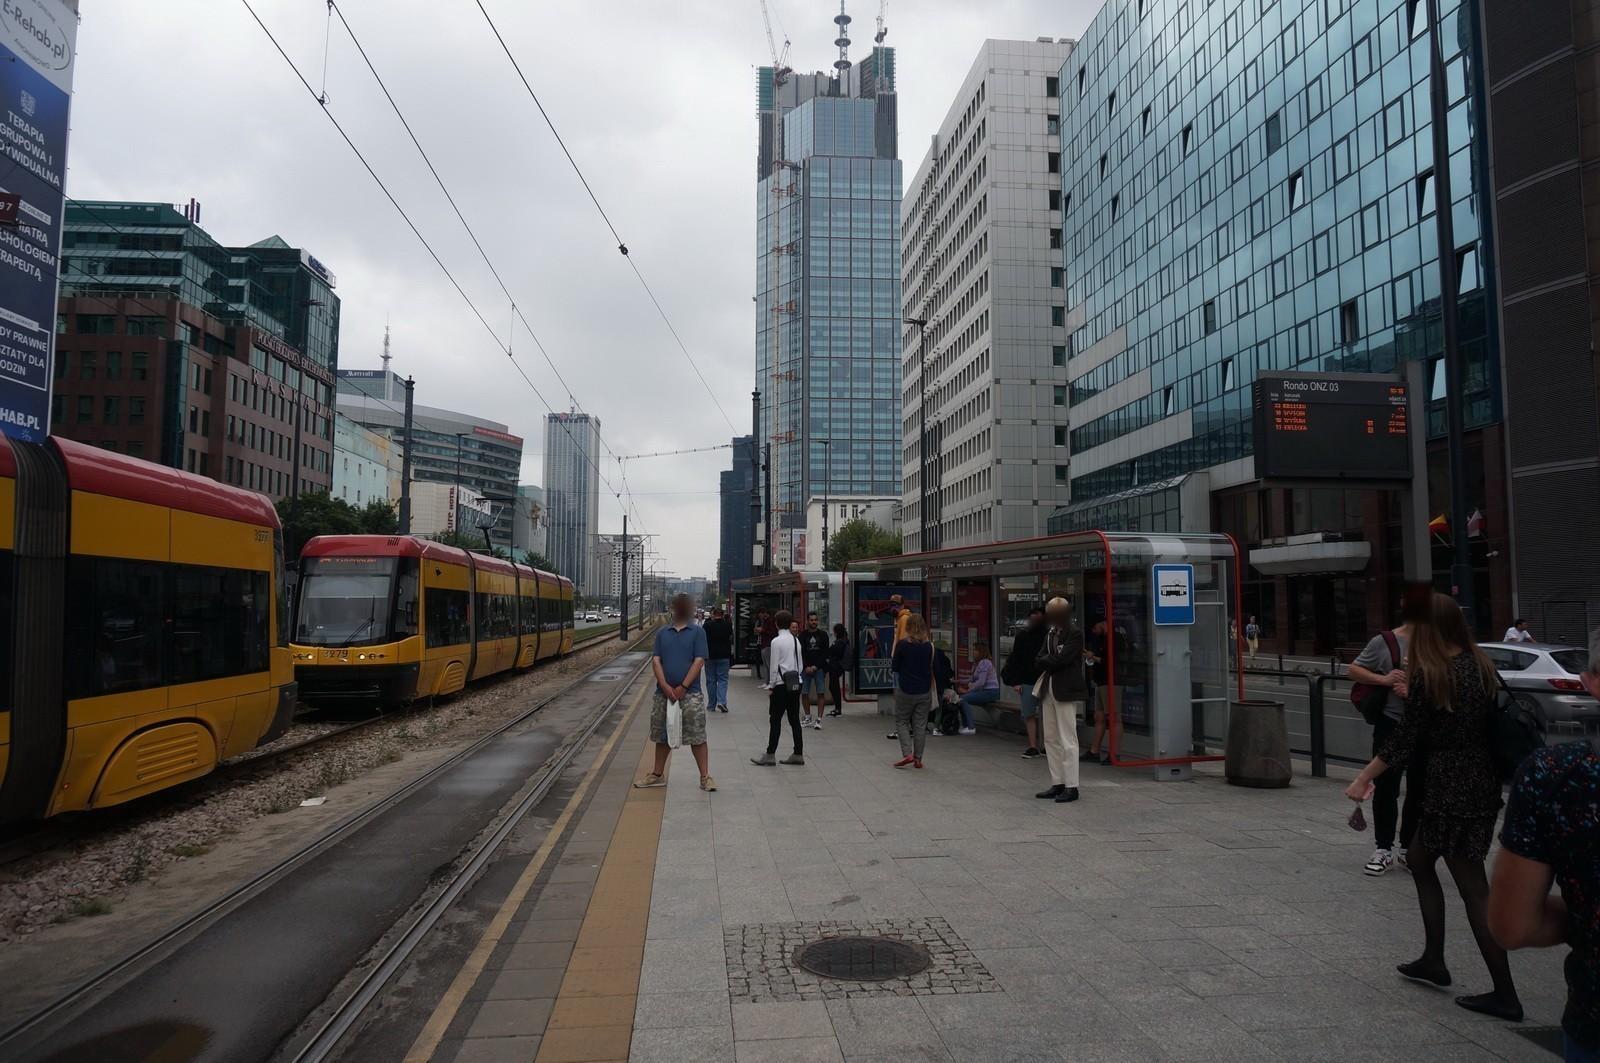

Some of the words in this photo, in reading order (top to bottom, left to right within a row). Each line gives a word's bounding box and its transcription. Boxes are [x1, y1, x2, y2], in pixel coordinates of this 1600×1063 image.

[3, 0, 65, 59] E-Rehab.pl
[7, 110, 45, 145] TERAPIA
[0, 123, 47, 162] GRUPOWA
[48, 154, 52, 166] I
[13, 331, 47, 352] PRAWNE
[28, 355, 45, 368] DLA
[1283, 381, 1308, 391] Rondo
[1310, 382, 1328, 391] ONZ
[1329, 382, 1339, 392] 03
[0, 407, 40, 430] HAB.PL
